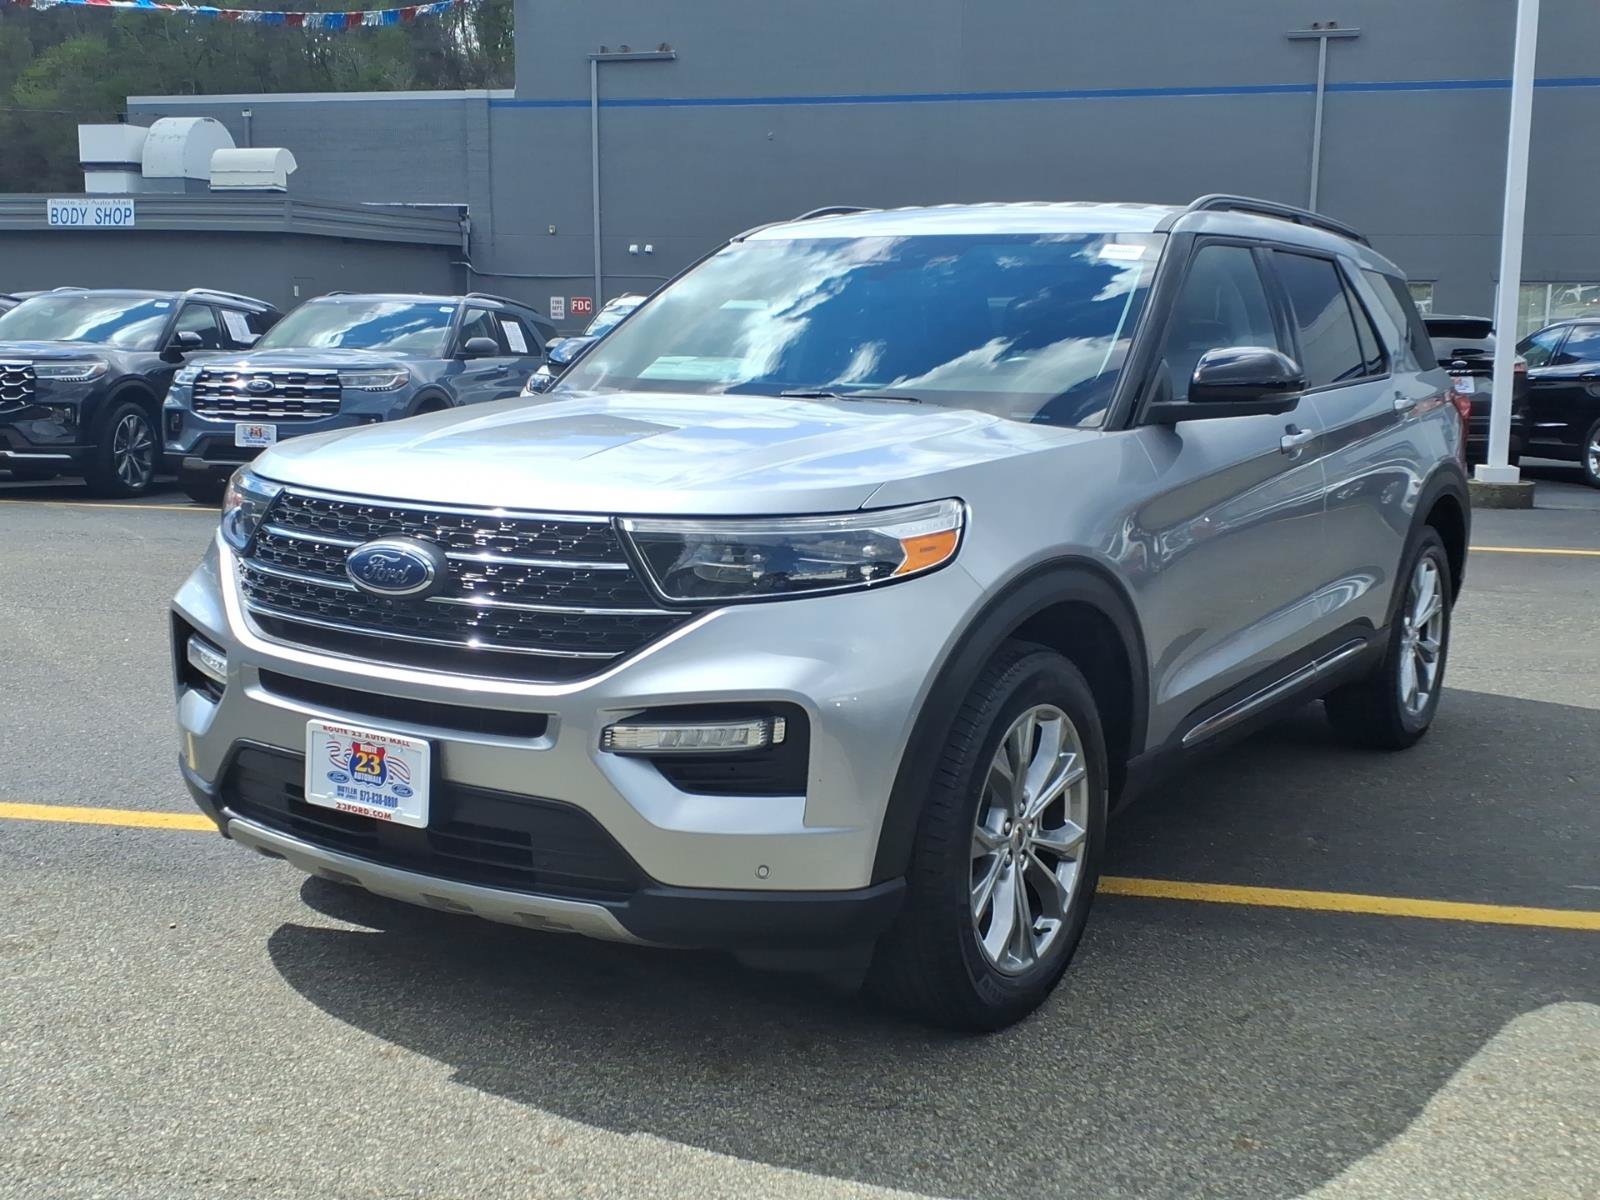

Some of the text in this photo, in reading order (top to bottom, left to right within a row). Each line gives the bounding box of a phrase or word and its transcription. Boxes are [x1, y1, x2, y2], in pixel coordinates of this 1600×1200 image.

[51, 207, 132, 224] BODY SHOP
[572, 300, 591, 311] FDC
[363, 554, 413, 584] Ford
[322, 725, 411, 747] ROUTE 23 AUTO MALL
[355, 752, 381, 775] 23
[336, 802, 392, 820] 23FORD.COM
